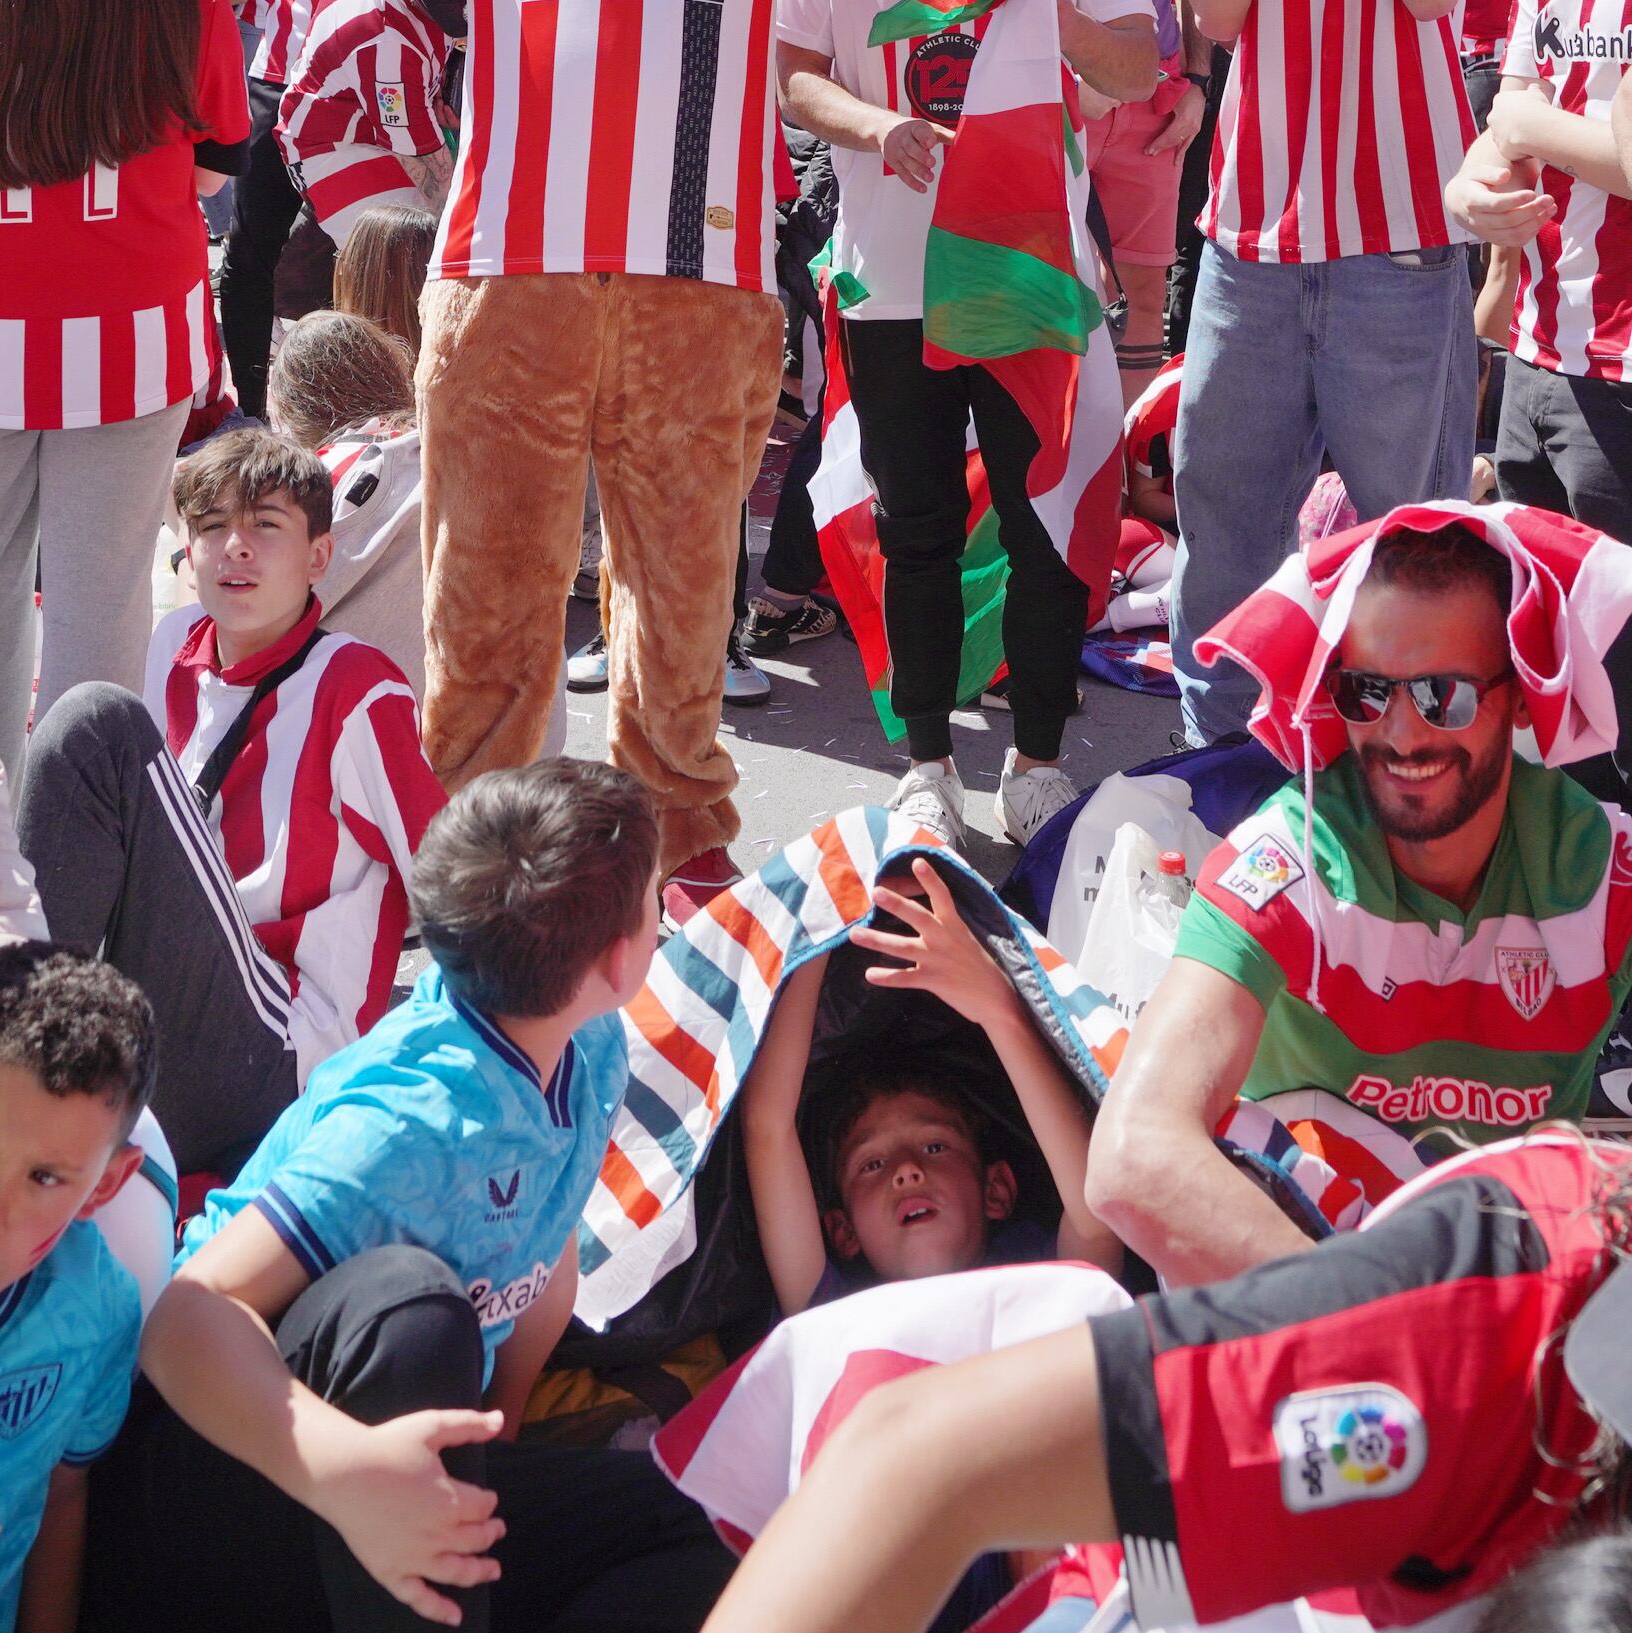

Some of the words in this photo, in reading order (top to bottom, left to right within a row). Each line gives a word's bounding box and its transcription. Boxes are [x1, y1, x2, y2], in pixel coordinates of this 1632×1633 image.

[916, 36, 961, 58] ATHLETIC
[384, 114, 401, 125] LFP
[1228, 874, 1259, 896] LFP
[1515, 997, 1543, 1016] BILBAO
[1347, 1076, 1551, 1124] Petronor
